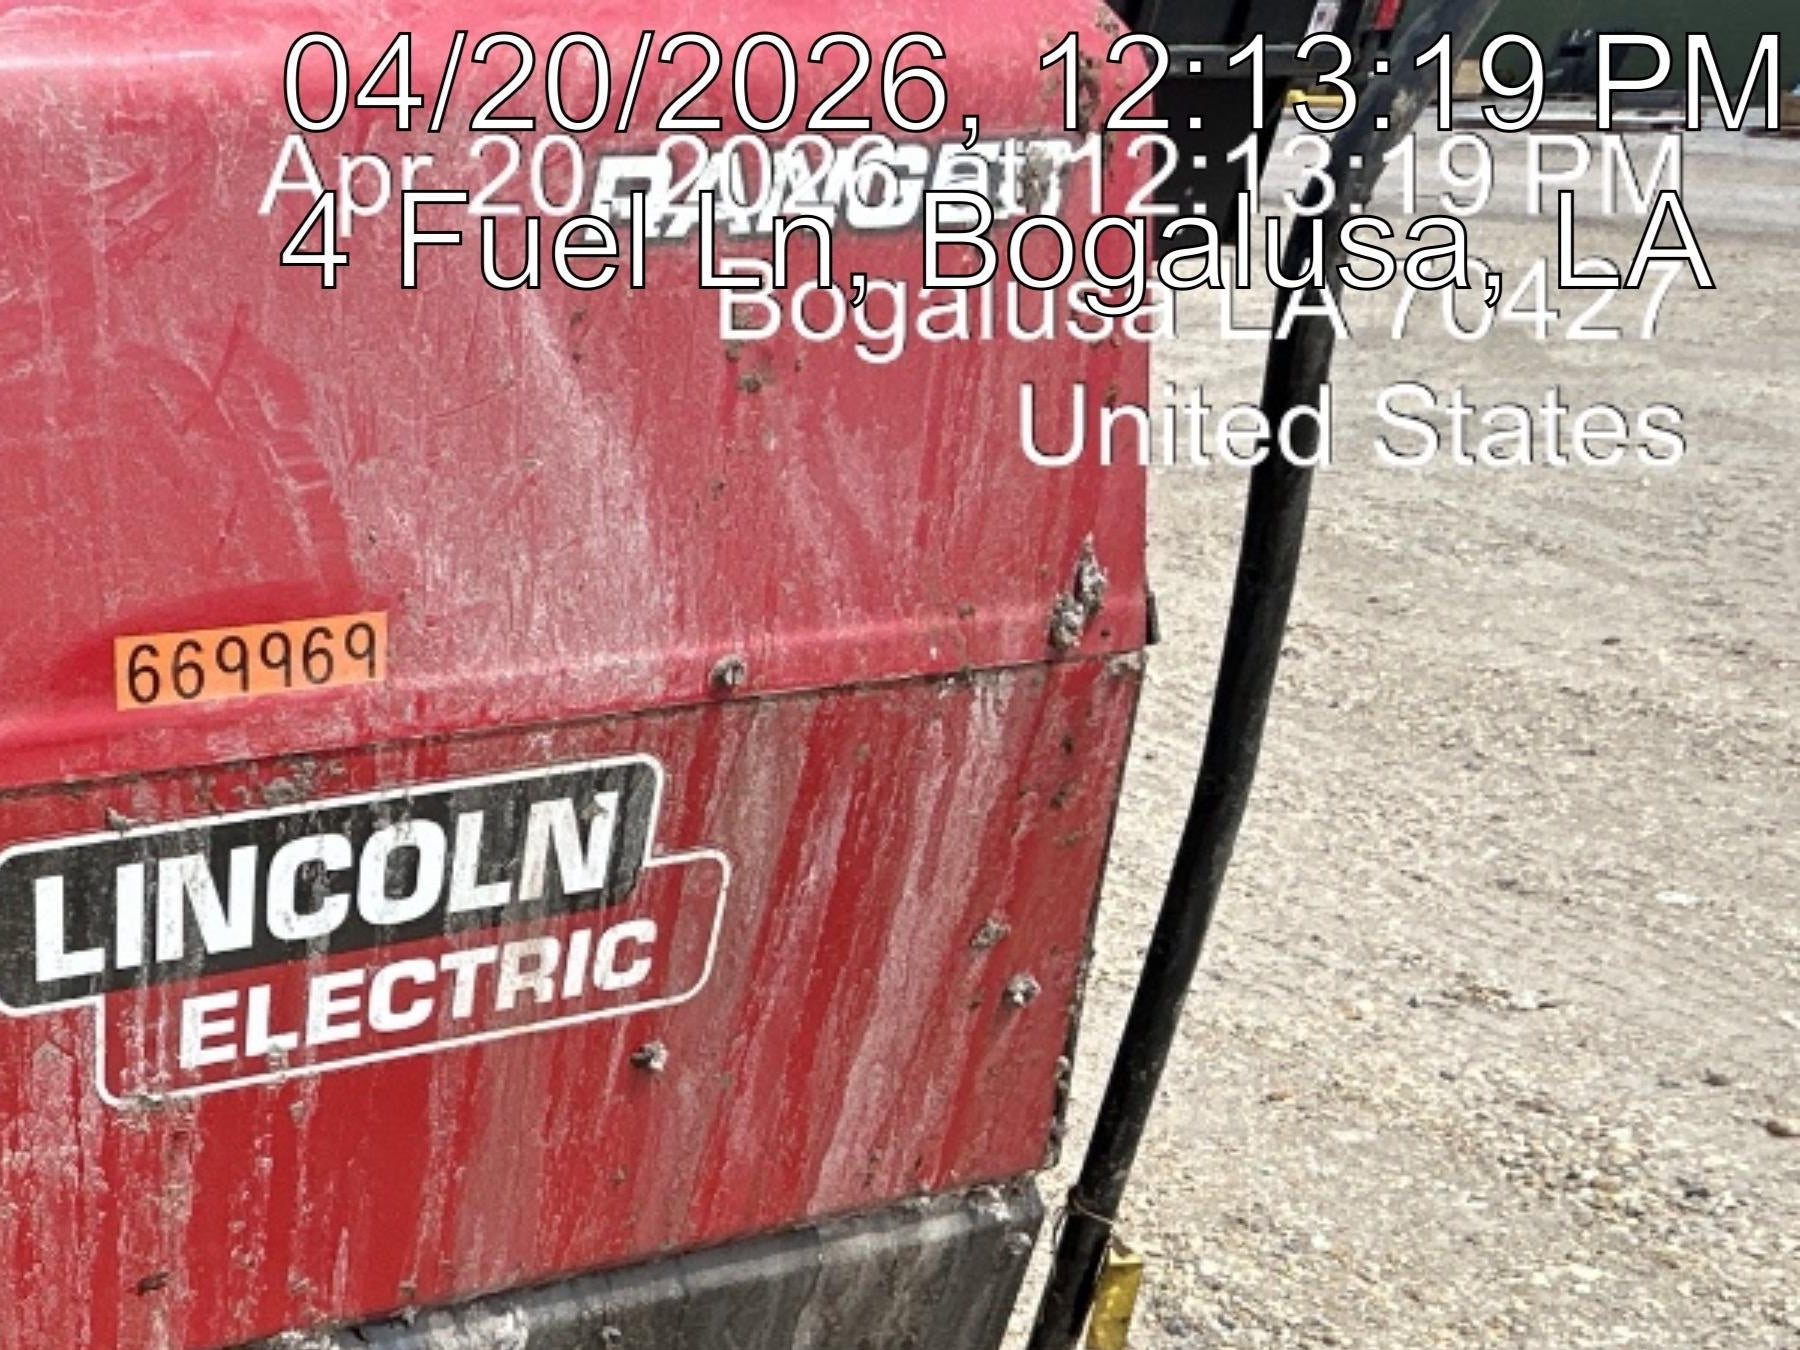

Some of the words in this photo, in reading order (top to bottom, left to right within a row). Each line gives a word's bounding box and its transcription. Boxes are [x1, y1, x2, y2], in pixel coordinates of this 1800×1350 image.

[126, 619, 379, 704] 669969
[32, 790, 620, 983] LINCOLN
[178, 918, 658, 1071] ELECTRIC
